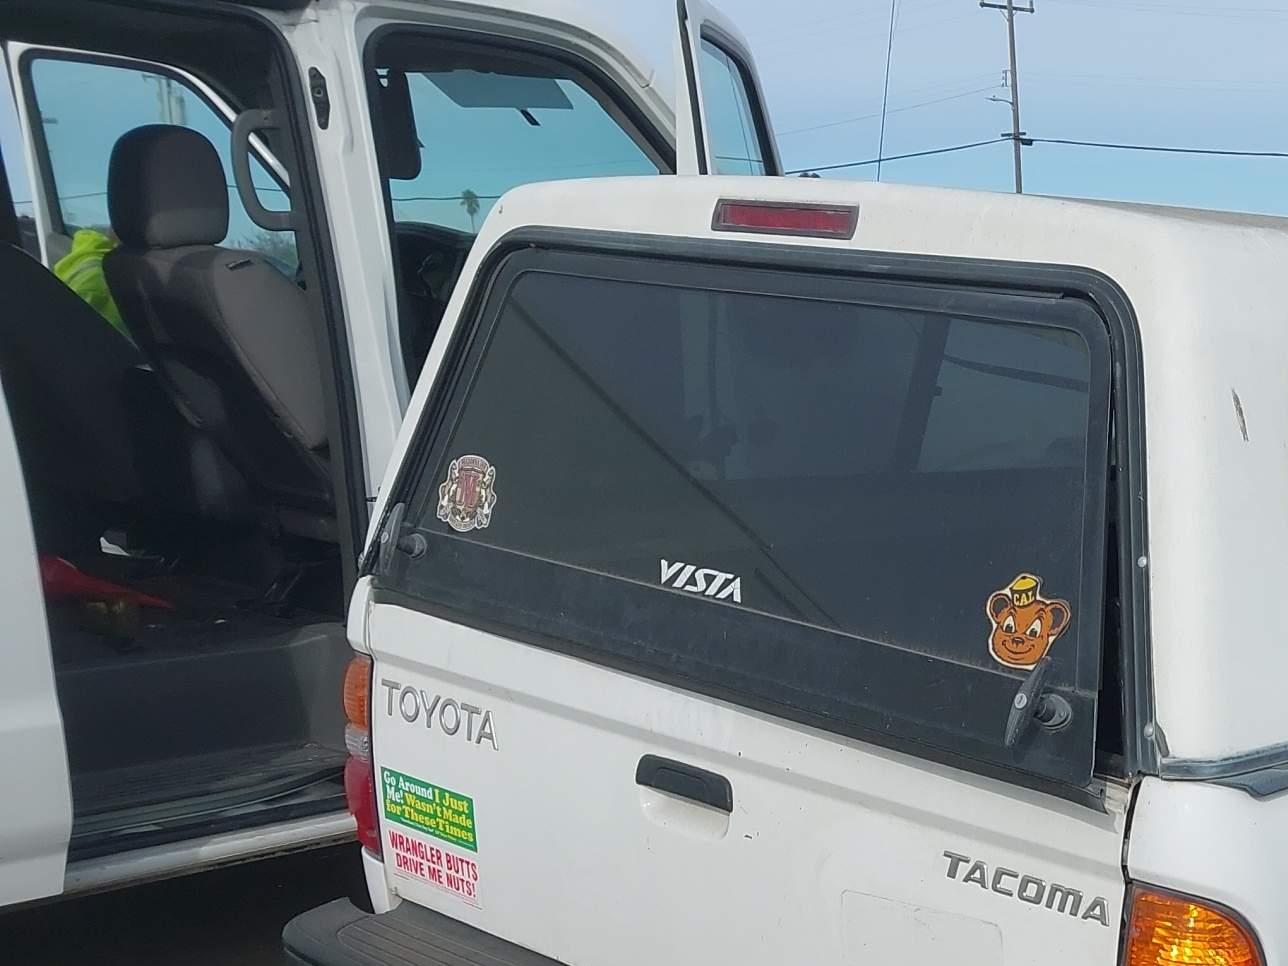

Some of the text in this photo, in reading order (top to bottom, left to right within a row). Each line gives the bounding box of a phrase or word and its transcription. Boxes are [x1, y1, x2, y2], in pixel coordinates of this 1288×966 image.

[660, 559, 741, 604] VISTA
[1013, 591, 1035, 607] CAL
[381, 678, 499, 752] TOYOTA
[383, 771, 469, 813] Go Around I Just
[386, 785, 473, 828] Me! Wasn't Made
[386, 799, 402, 815] for
[402, 805, 437, 827] These
[436, 818, 474, 842] Times
[388, 830, 443, 868] WRANGLER
[445, 852, 478, 882] BUTTS
[396, 853, 476, 898] DRIVE ME NUTS!
[943, 850, 1110, 927] TACOMA
